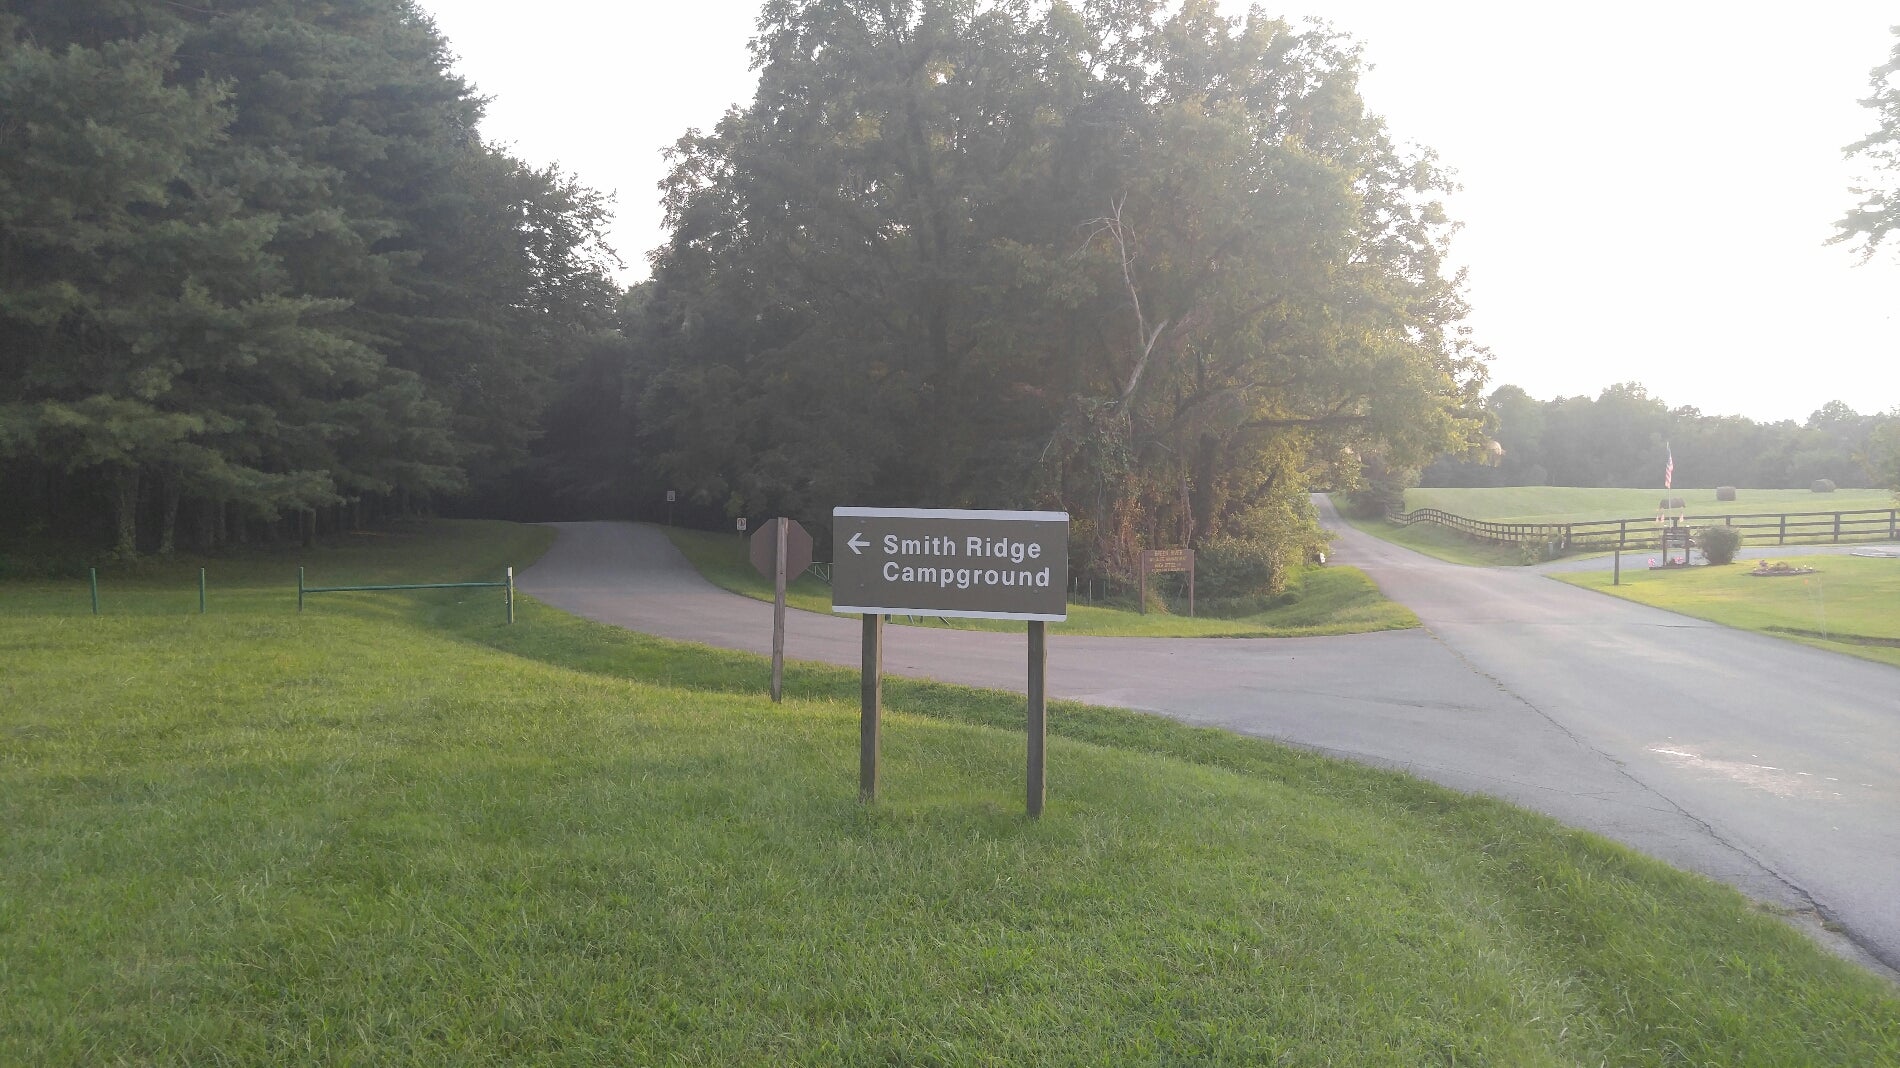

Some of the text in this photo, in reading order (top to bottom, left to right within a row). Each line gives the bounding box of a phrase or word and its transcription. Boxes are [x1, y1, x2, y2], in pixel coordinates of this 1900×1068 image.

[883, 534, 1041, 563] Smith Ridge
[883, 561, 1050, 589] Campground
